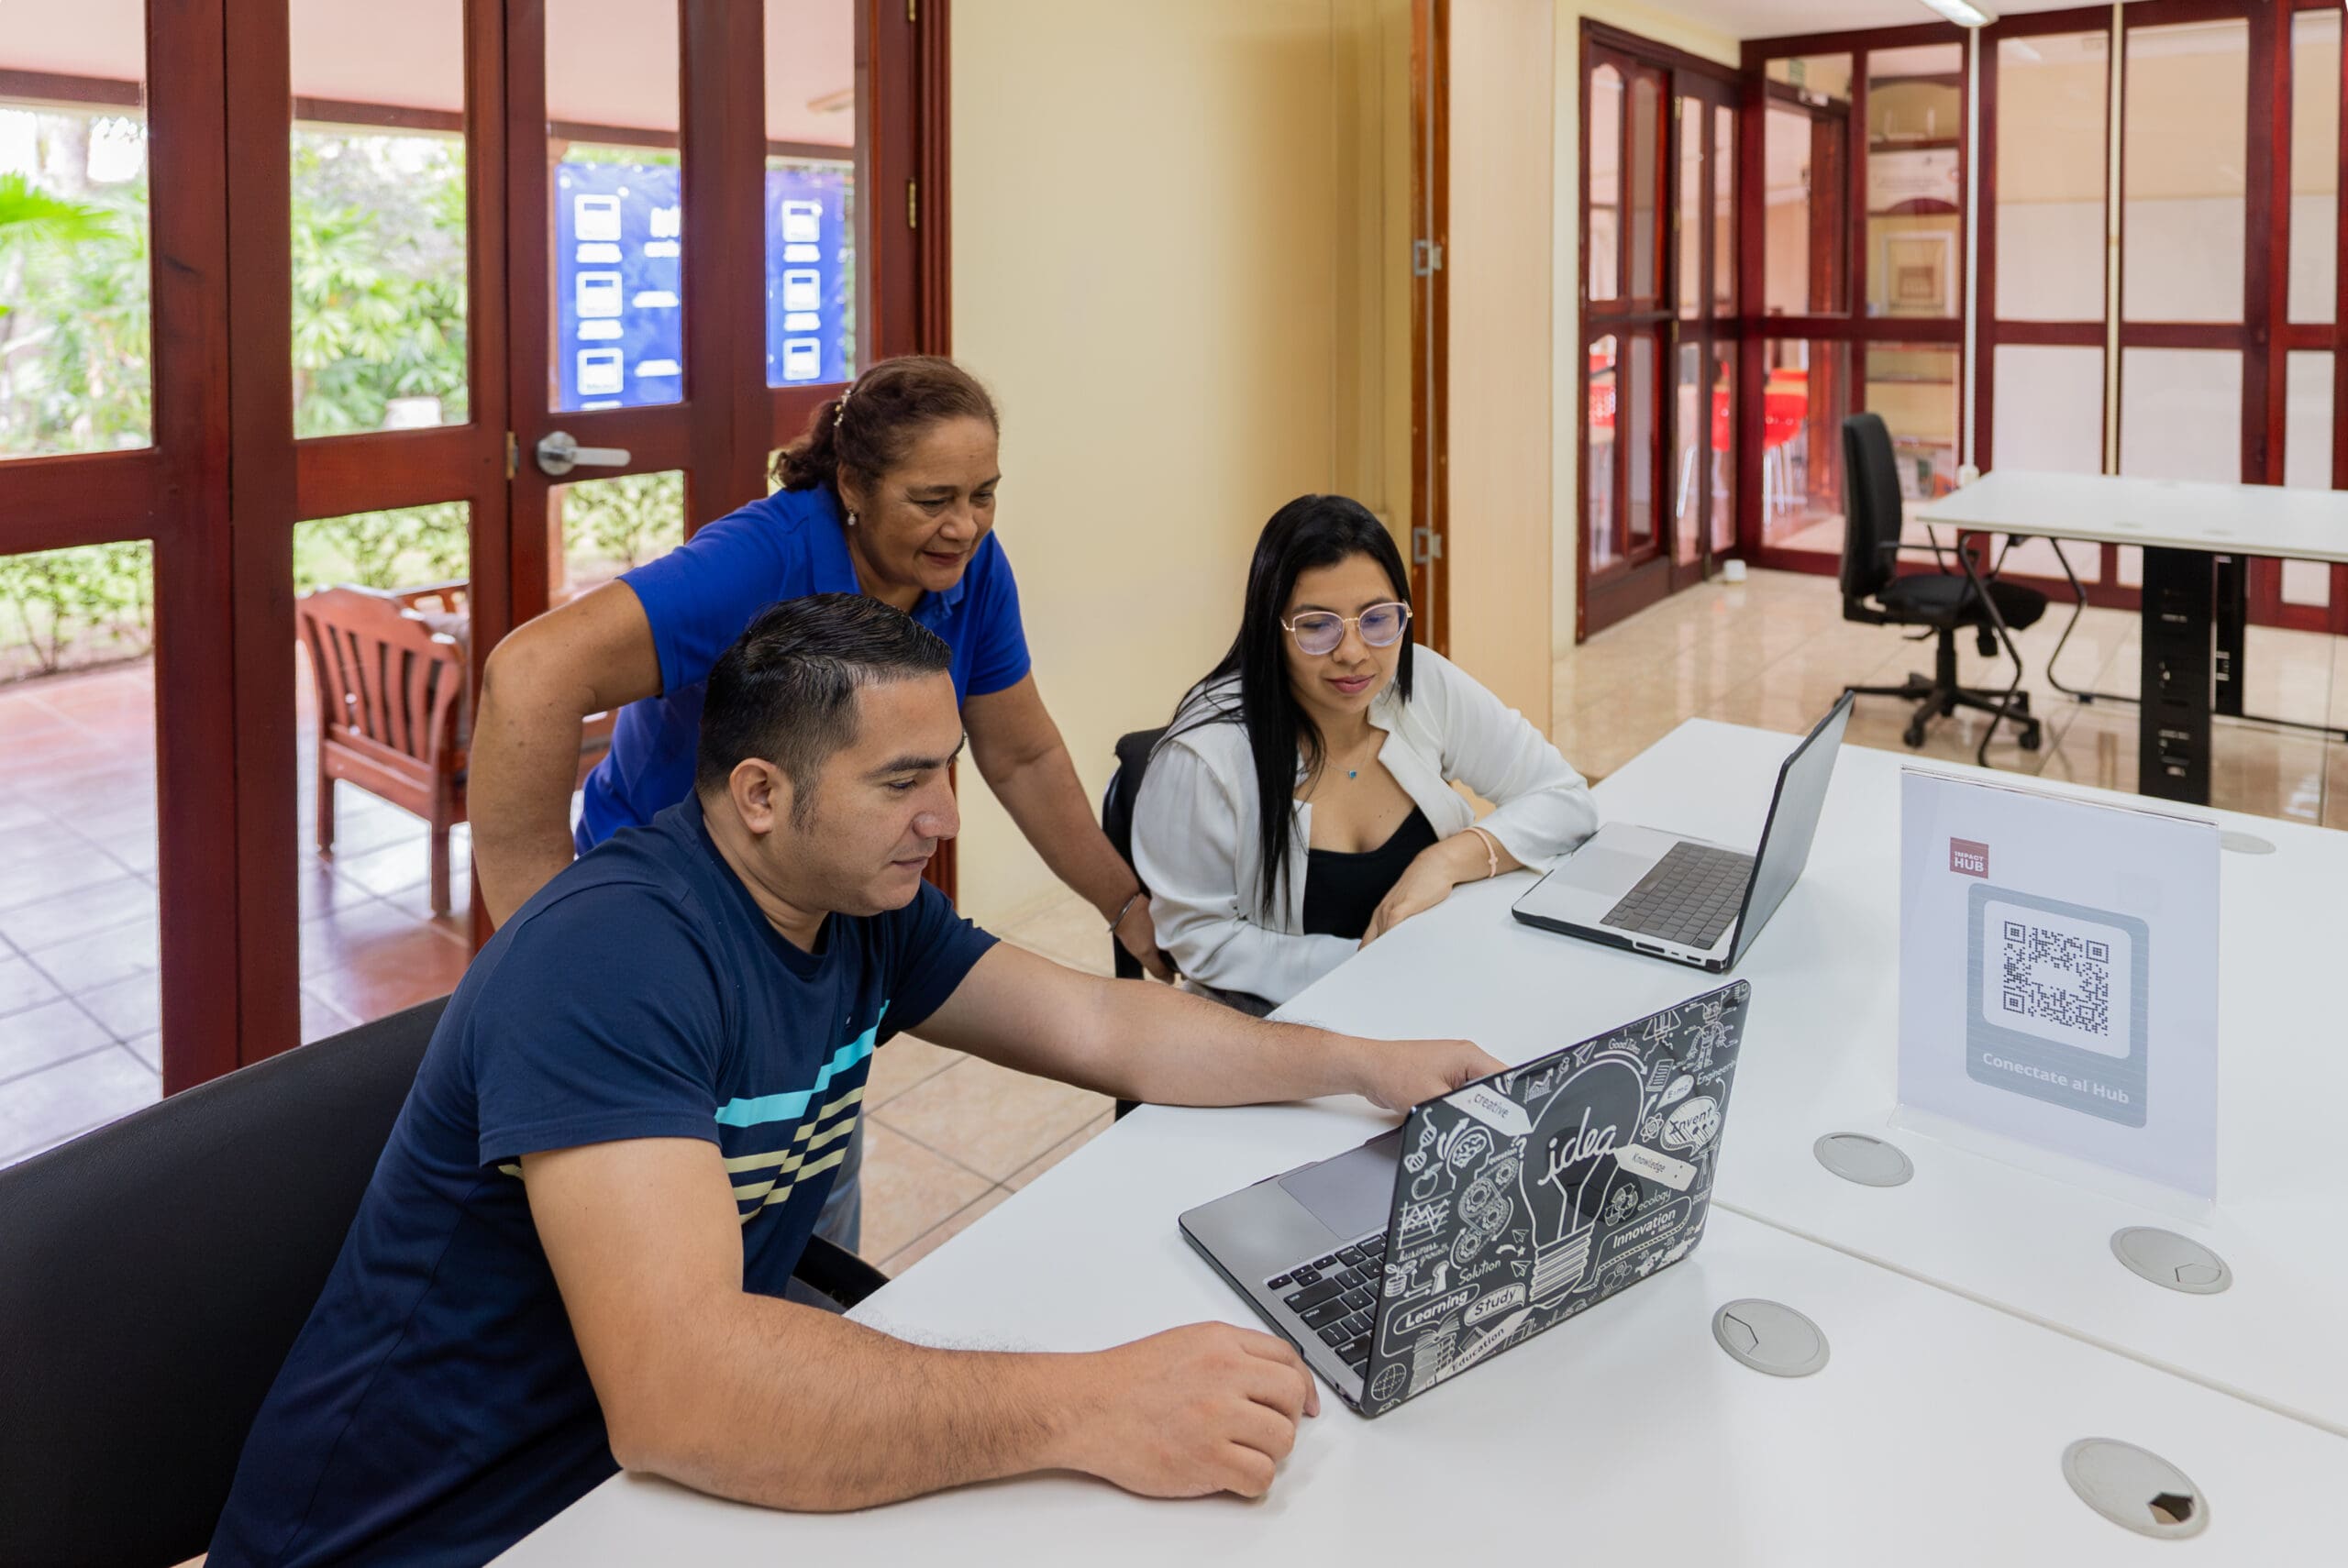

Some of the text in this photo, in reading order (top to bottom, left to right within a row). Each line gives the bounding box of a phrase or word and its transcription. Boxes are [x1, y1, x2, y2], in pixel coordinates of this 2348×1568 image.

[1954, 851, 1984, 862] IMPACT
[1954, 856, 1984, 872] HUB
[1982, 1053, 2130, 1104] Conectate al Hub
[1474, 1093, 1511, 1119] creative
[1537, 1106, 1618, 1187] idea
[1636, 1188, 1672, 1211] ecology
[1612, 1209, 1677, 1249] Innovation
[1457, 1259, 1501, 1286] Solution
[1404, 1290, 1468, 1329] Learning
[1474, 1287, 1516, 1317] Study
[1451, 1327, 1505, 1373] Education
